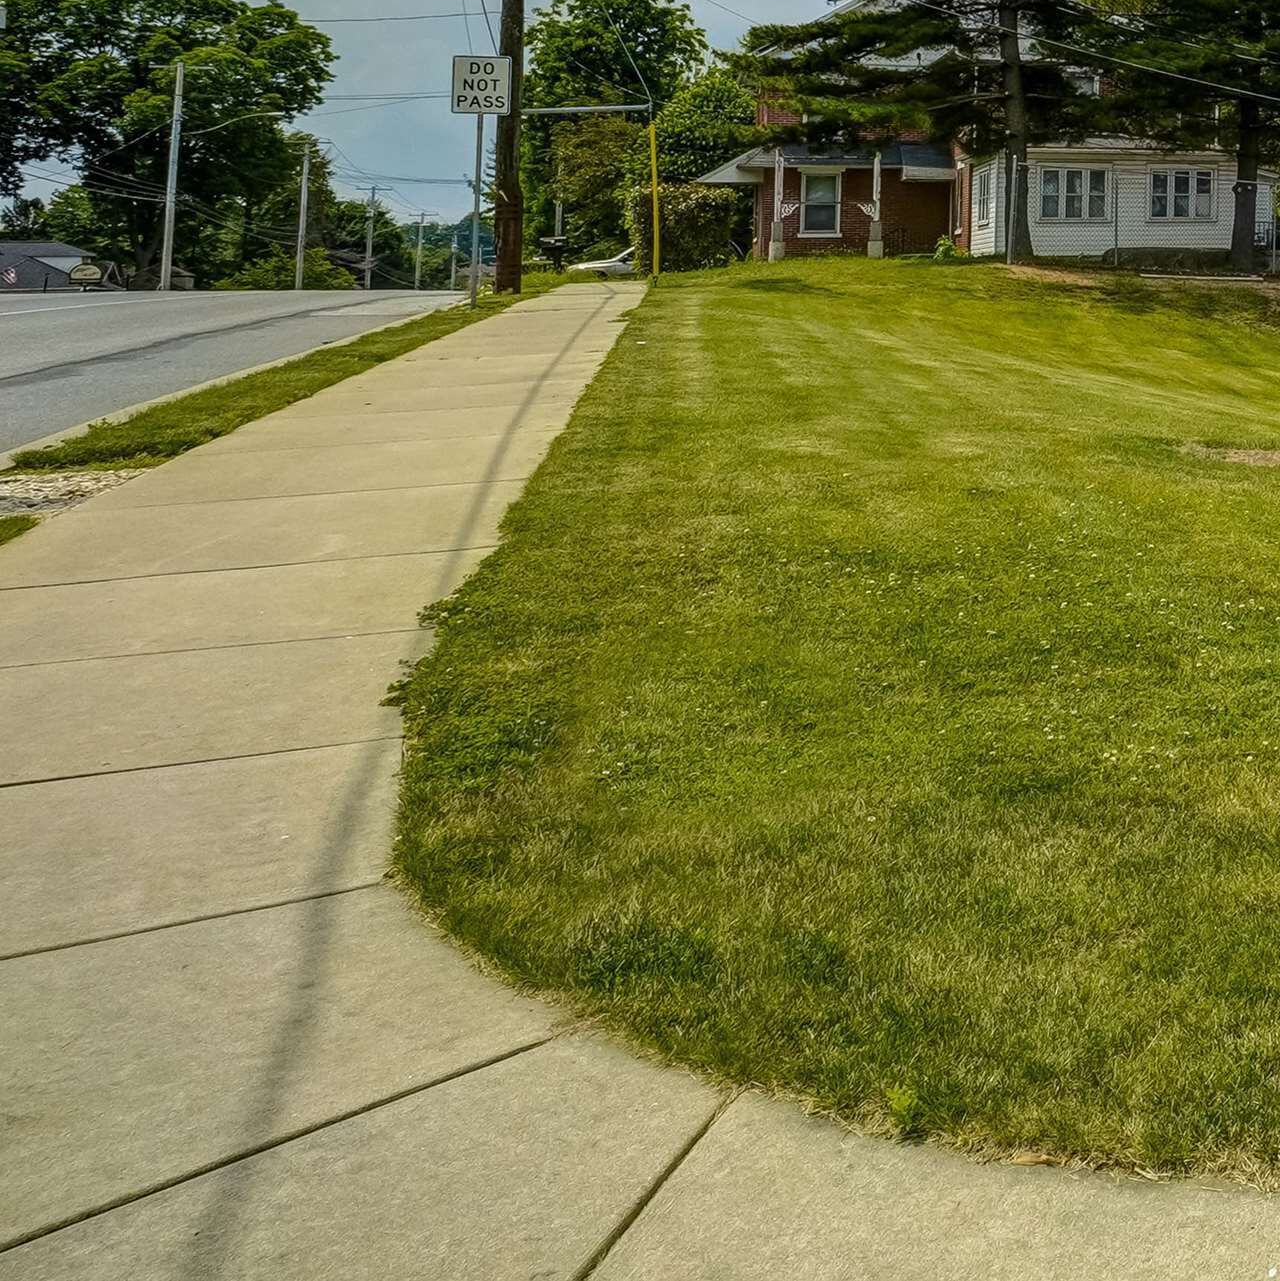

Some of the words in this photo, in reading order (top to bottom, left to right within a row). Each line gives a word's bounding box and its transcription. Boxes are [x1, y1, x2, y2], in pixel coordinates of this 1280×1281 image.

[469, 62, 495, 75] DO
[463, 78, 501, 92] NOT
[456, 95, 505, 109] PASS
